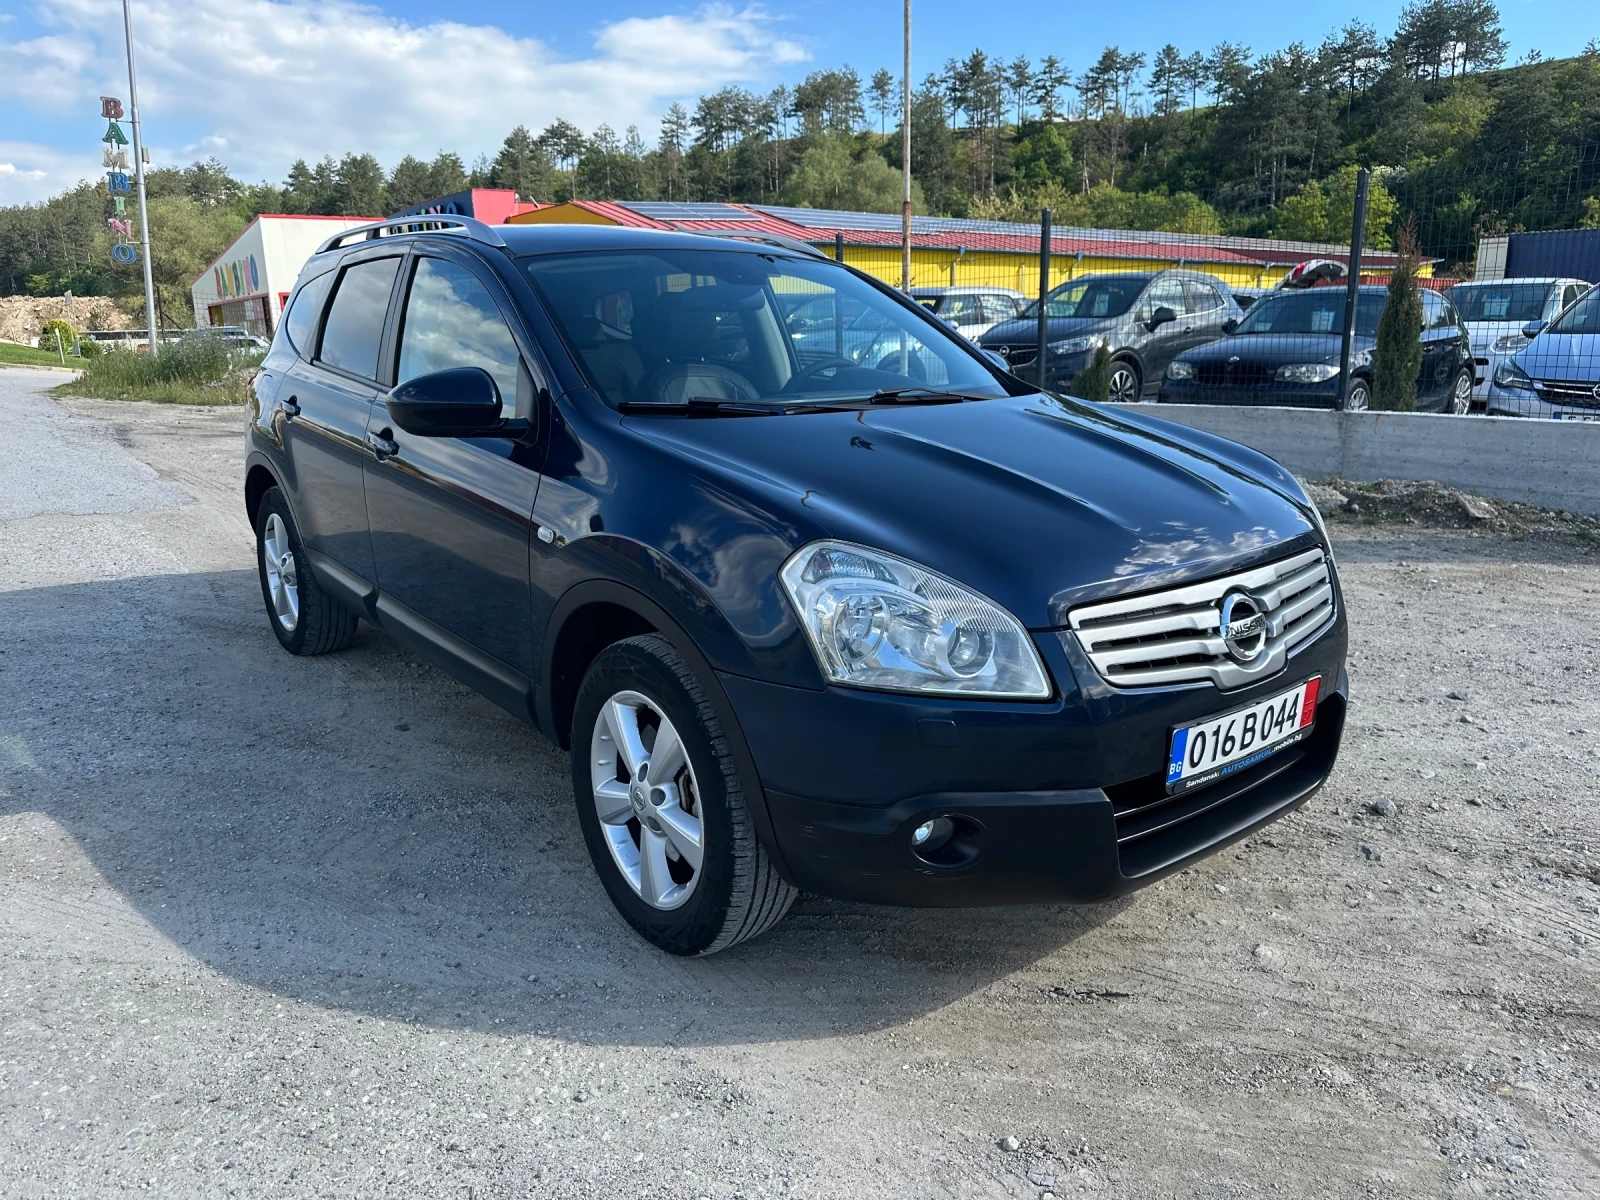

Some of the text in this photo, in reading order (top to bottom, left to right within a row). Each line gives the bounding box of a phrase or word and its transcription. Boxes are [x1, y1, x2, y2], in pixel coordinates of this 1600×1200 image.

[100, 96, 137, 264] BAMBINO
[214, 253, 259, 299] BAMBINO
[1169, 761, 1182, 776] BG
